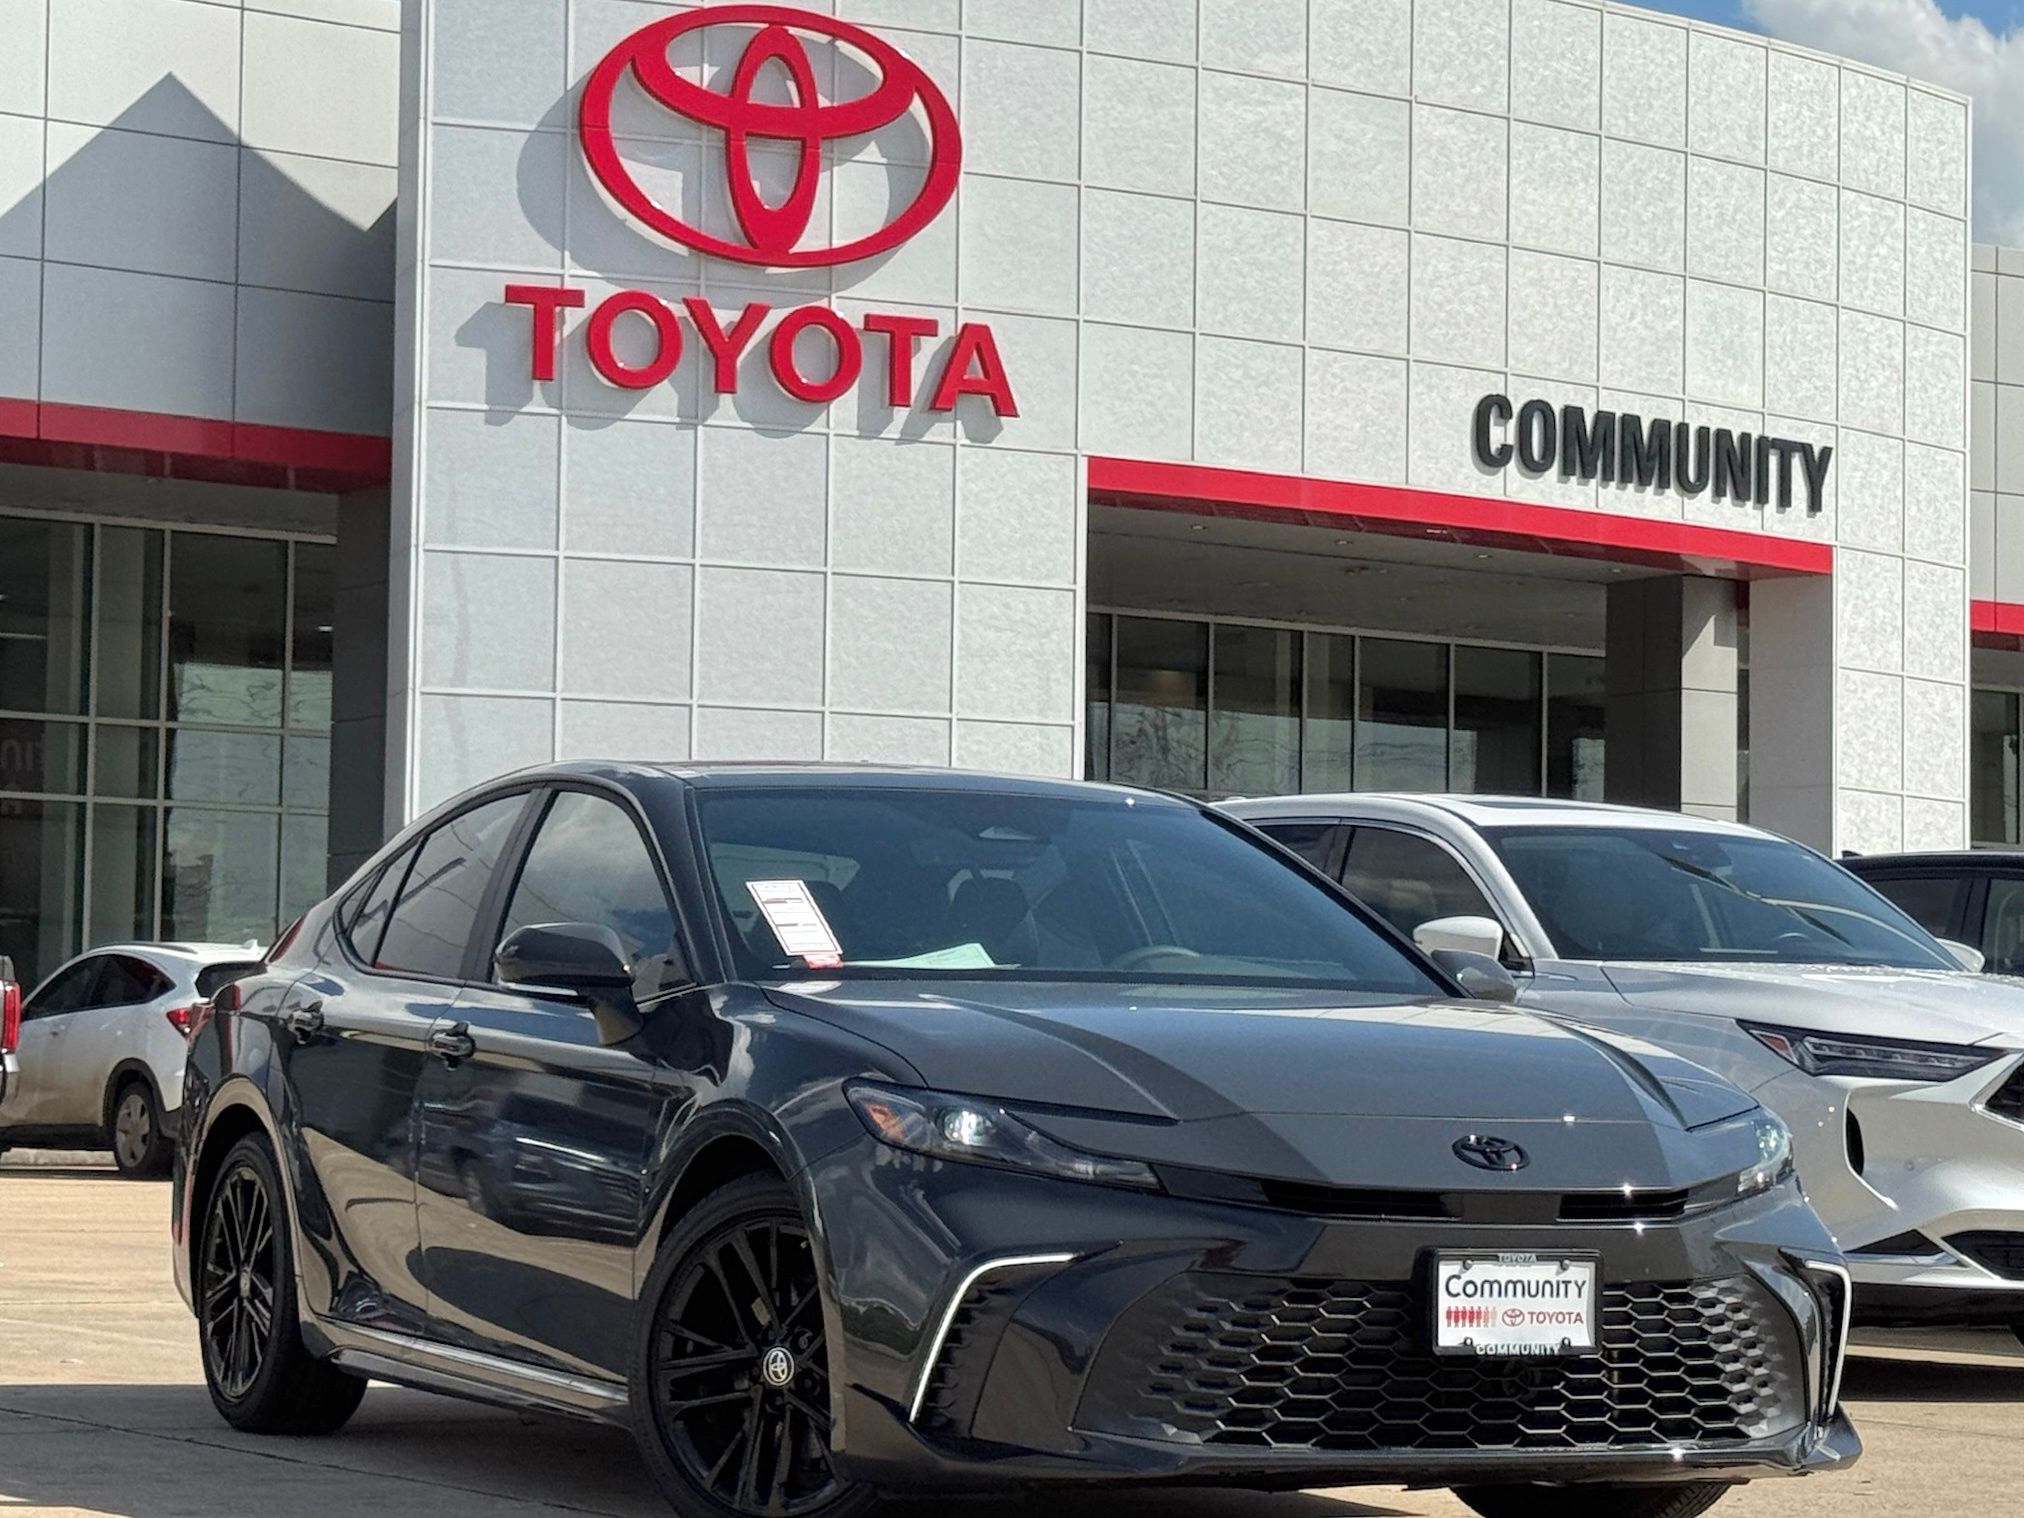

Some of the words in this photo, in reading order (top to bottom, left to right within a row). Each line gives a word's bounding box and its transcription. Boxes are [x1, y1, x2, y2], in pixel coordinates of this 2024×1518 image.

[505, 284, 1020, 418] TOYOTA
[1474, 393, 1833, 513] COMMUNITY
[1500, 1253, 1537, 1263] TOYOTA
[1527, 1311, 1584, 1325] TOYOTA
[1476, 1343, 1560, 1356] COMMUNITY
